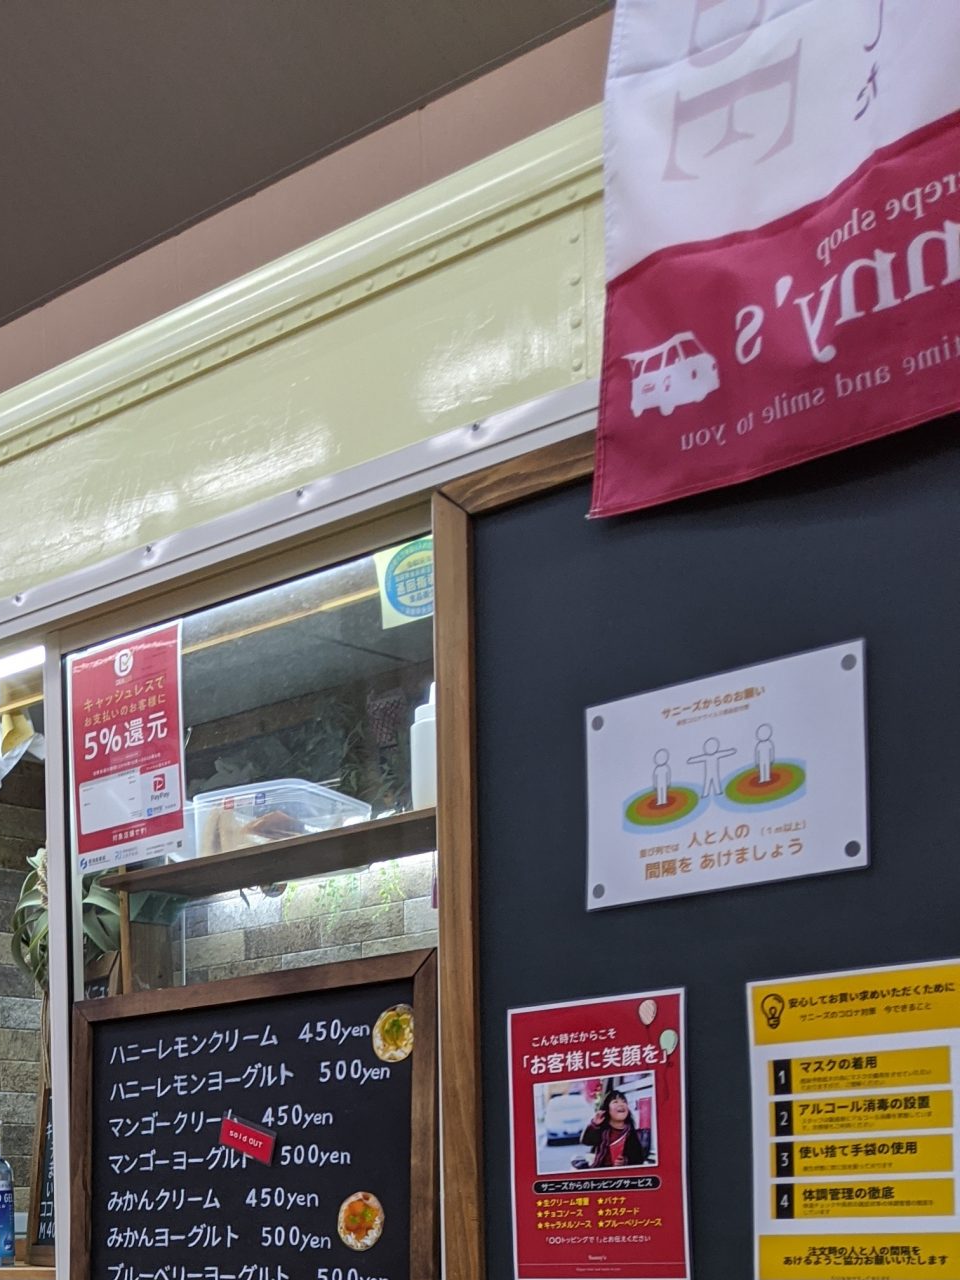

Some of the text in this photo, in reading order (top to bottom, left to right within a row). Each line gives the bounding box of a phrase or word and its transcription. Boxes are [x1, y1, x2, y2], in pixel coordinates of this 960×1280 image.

[83, 676, 166, 713] キャッシュレスで
[661, 686, 766, 720] サニーズからのお願い
[84, 694, 167, 728] お支払いのお客様に
[84, 710, 168, 760] 5%還元
[687, 823, 750, 849] 人と人の
[644, 837, 804, 881] 間隔を あけましょう
[788, 982, 956, 1009] 安心してお買い求めいただくために
[109, 1019, 371, 1066] ハニーレモンクリーム 450yen
[531, 1028, 617, 1048] こんな時だからこそ
[522, 1043, 668, 1075] 「お客様に笑顔を」
[799, 1055, 878, 1074] マスクの着用
[109, 1059, 391, 1101] ハニーレモンヨーグルト 500yen
[778, 1070, 786, 1085] 1
[262, 1104, 334, 1128] 450yen
[799, 1095, 931, 1117] アルコール消毒の設置
[780, 1111, 789, 1126] 2
[248, 1137, 263, 1149] OUT
[799, 1141, 918, 1160] 使い捨て手袋の使用
[108, 1143, 352, 1175] マンゴーヨーグルト 500yen
[780, 1152, 790, 1167] 3
[541, 1178, 653, 1192] サニーズからのトッピングサービス
[802, 1186, 895, 1202] 体調管理の徹底
[107, 1187, 320, 1212] みかんクリーム 450yen
[604, 1196, 627, 1205] バナナ
[780, 1194, 789, 1208] 4
[604, 1207, 640, 1217] カスタード
[107, 1225, 332, 1251] みかんヨーグルト 500yen
